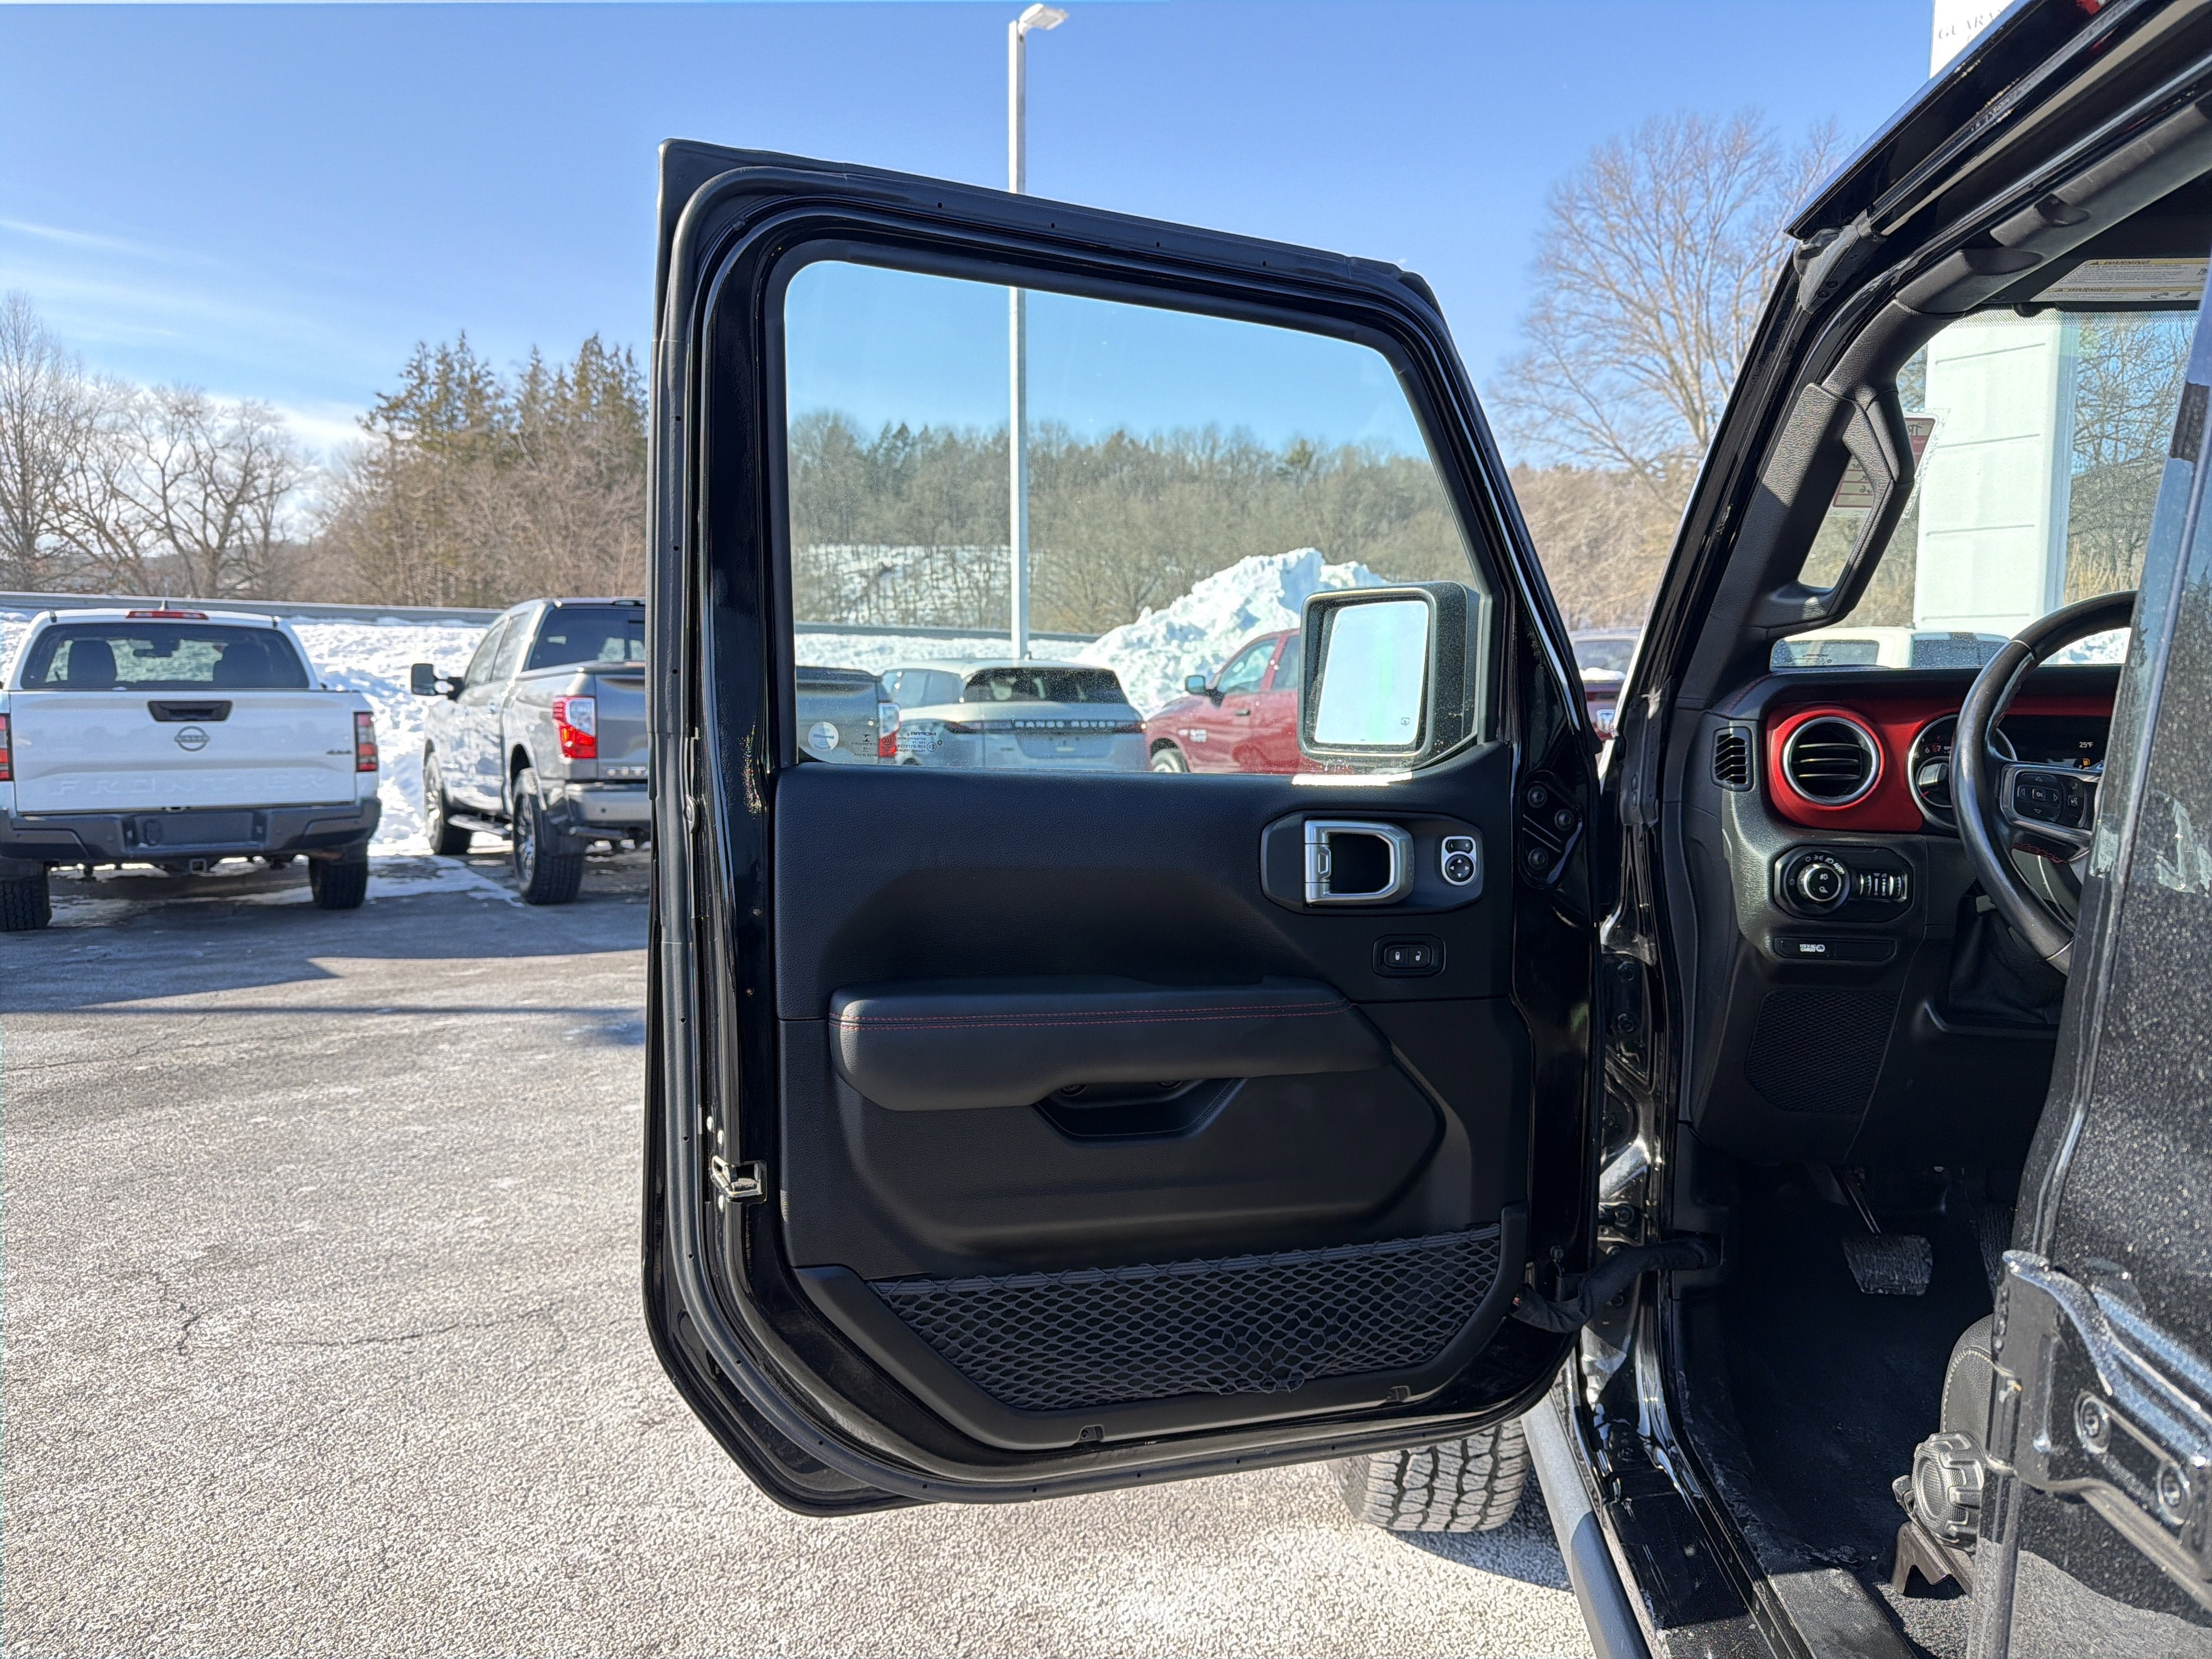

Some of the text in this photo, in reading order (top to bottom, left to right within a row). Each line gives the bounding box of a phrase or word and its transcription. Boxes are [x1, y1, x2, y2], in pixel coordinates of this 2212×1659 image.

[1938, 9, 2001, 40] GUARA
[605, 766, 648, 777] TIT
[1832, 862, 1845, 874] AUTO
